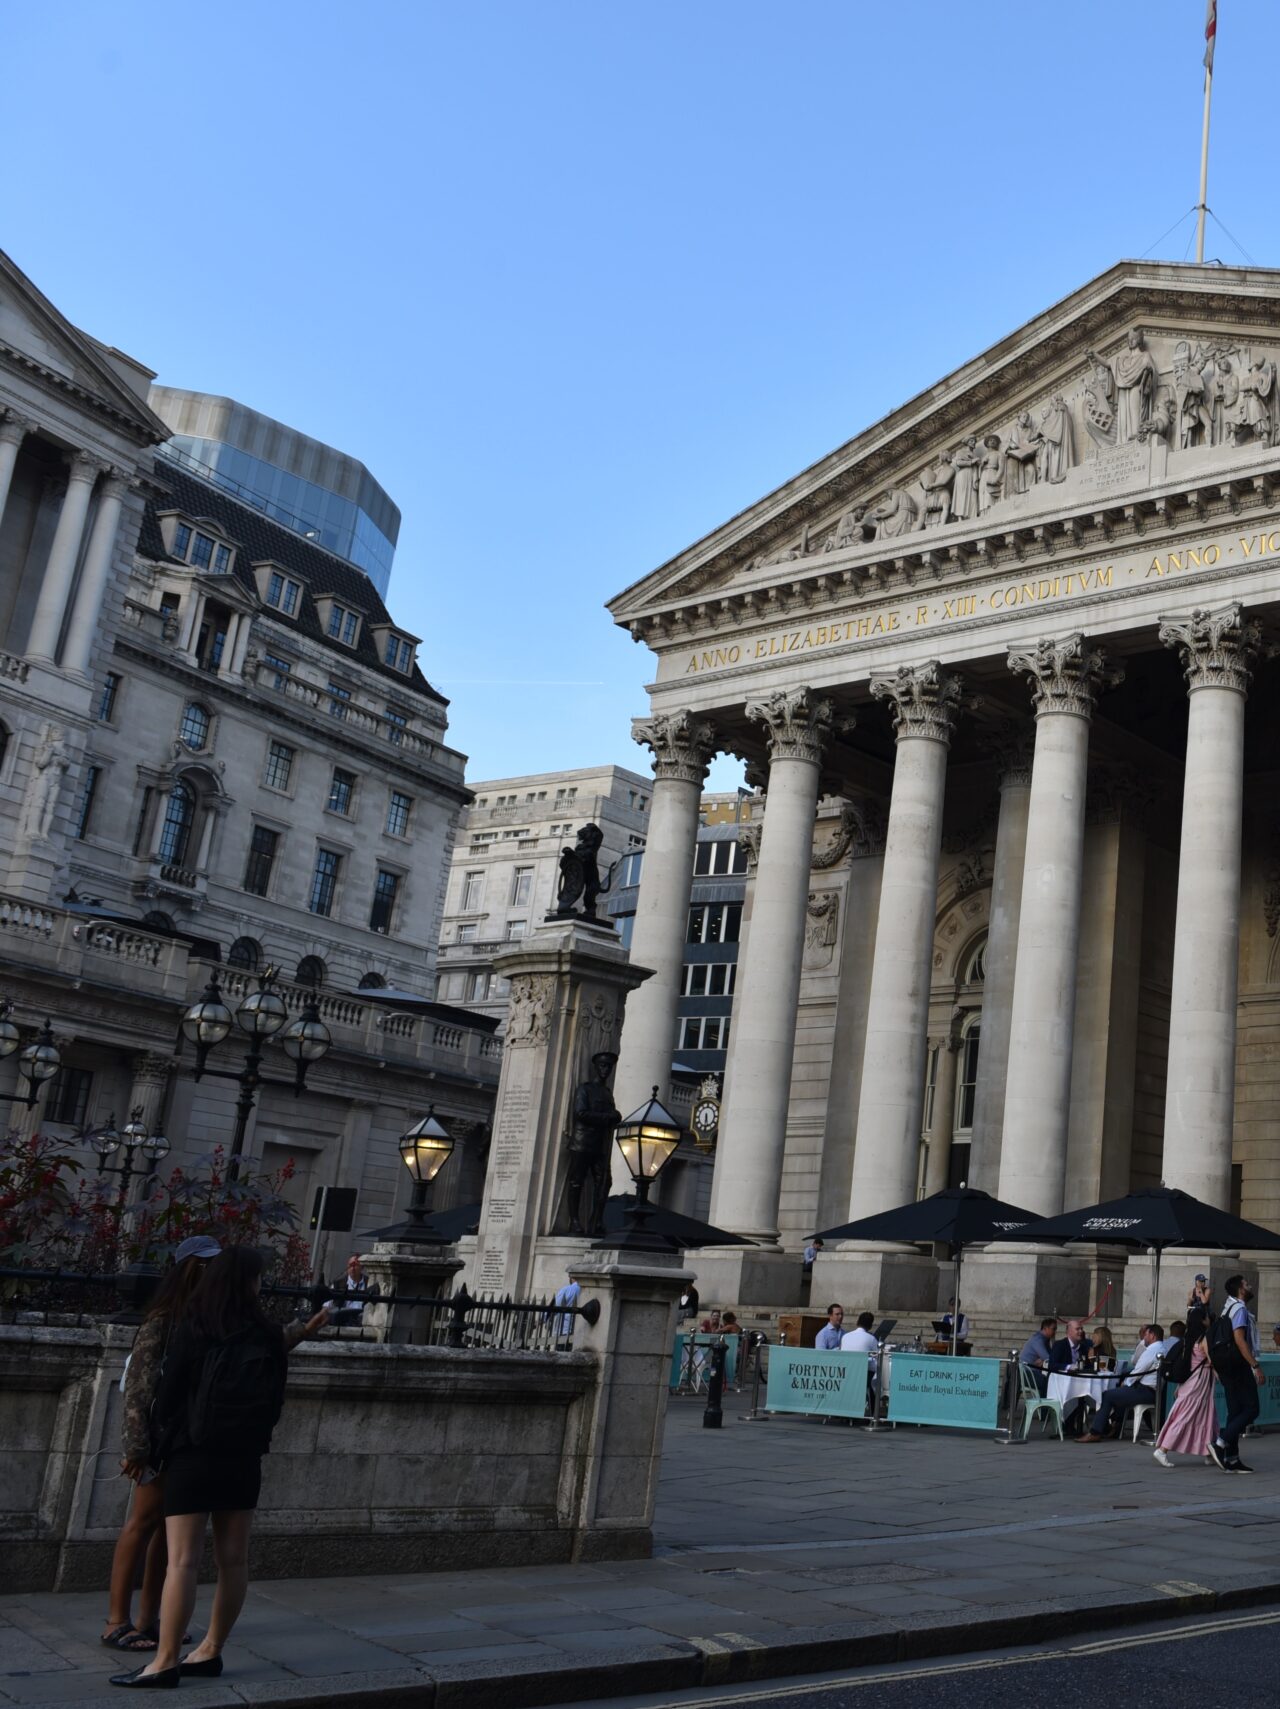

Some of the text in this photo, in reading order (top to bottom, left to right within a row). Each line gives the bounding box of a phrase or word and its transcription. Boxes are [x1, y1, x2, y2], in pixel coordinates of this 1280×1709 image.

[686, 644, 742, 674] ANNO
[754, 611, 901, 659] ELIZABETHAE
[915, 606, 930, 626] R
[940, 594, 977, 621] XIII
[989, 566, 1114, 610] CONDITVM
[1145, 543, 1222, 580] ANNO
[788, 1363, 847, 1379] FORTNUM
[909, 1369, 979, 1382] EAT DRINK SHOP
[791, 1377, 841, 1392] &MASON
[898, 1382, 989, 1398] Inside the Royal Exchange
